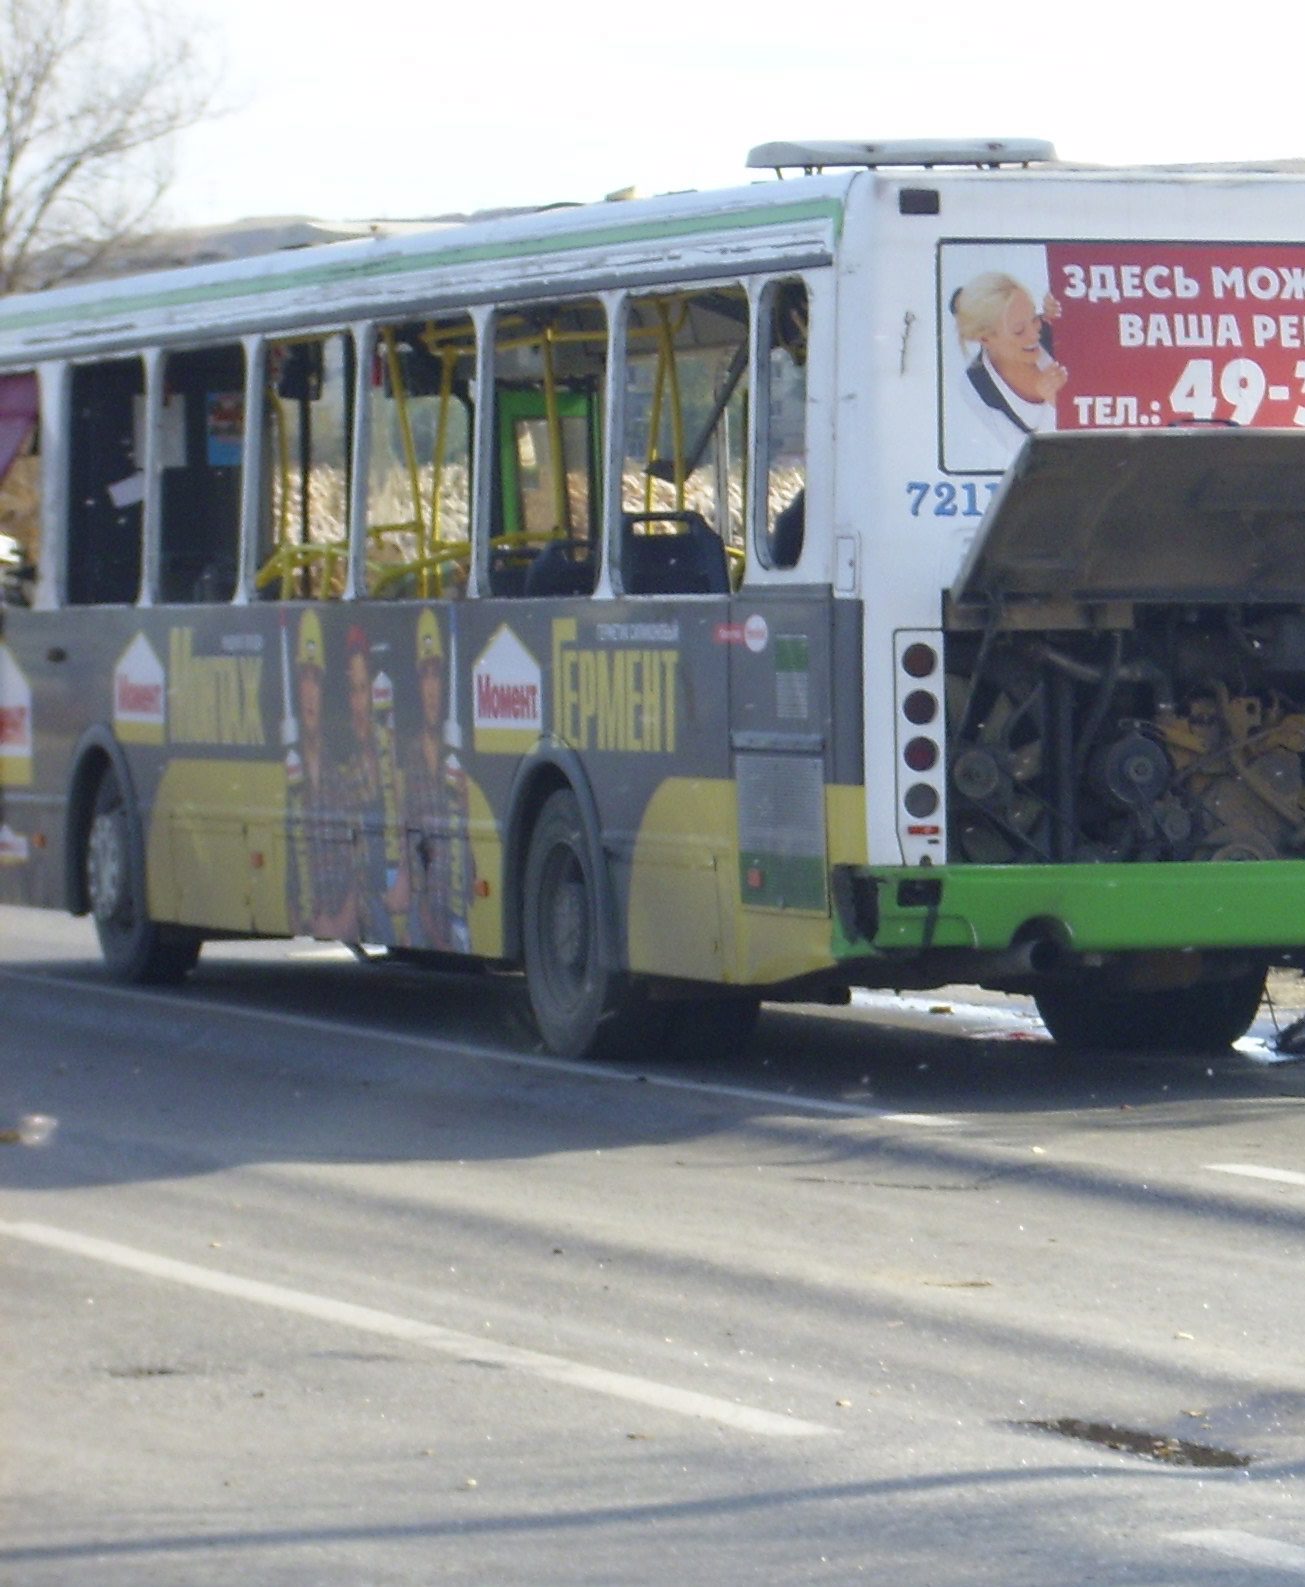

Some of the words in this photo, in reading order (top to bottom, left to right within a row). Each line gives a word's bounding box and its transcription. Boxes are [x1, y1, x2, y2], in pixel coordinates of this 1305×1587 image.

[1062, 263, 1199, 304] ЗДЕСЬ
[1118, 313, 1242, 348] ВАША
[1073, 394, 1162, 426] ТЕЛ.:
